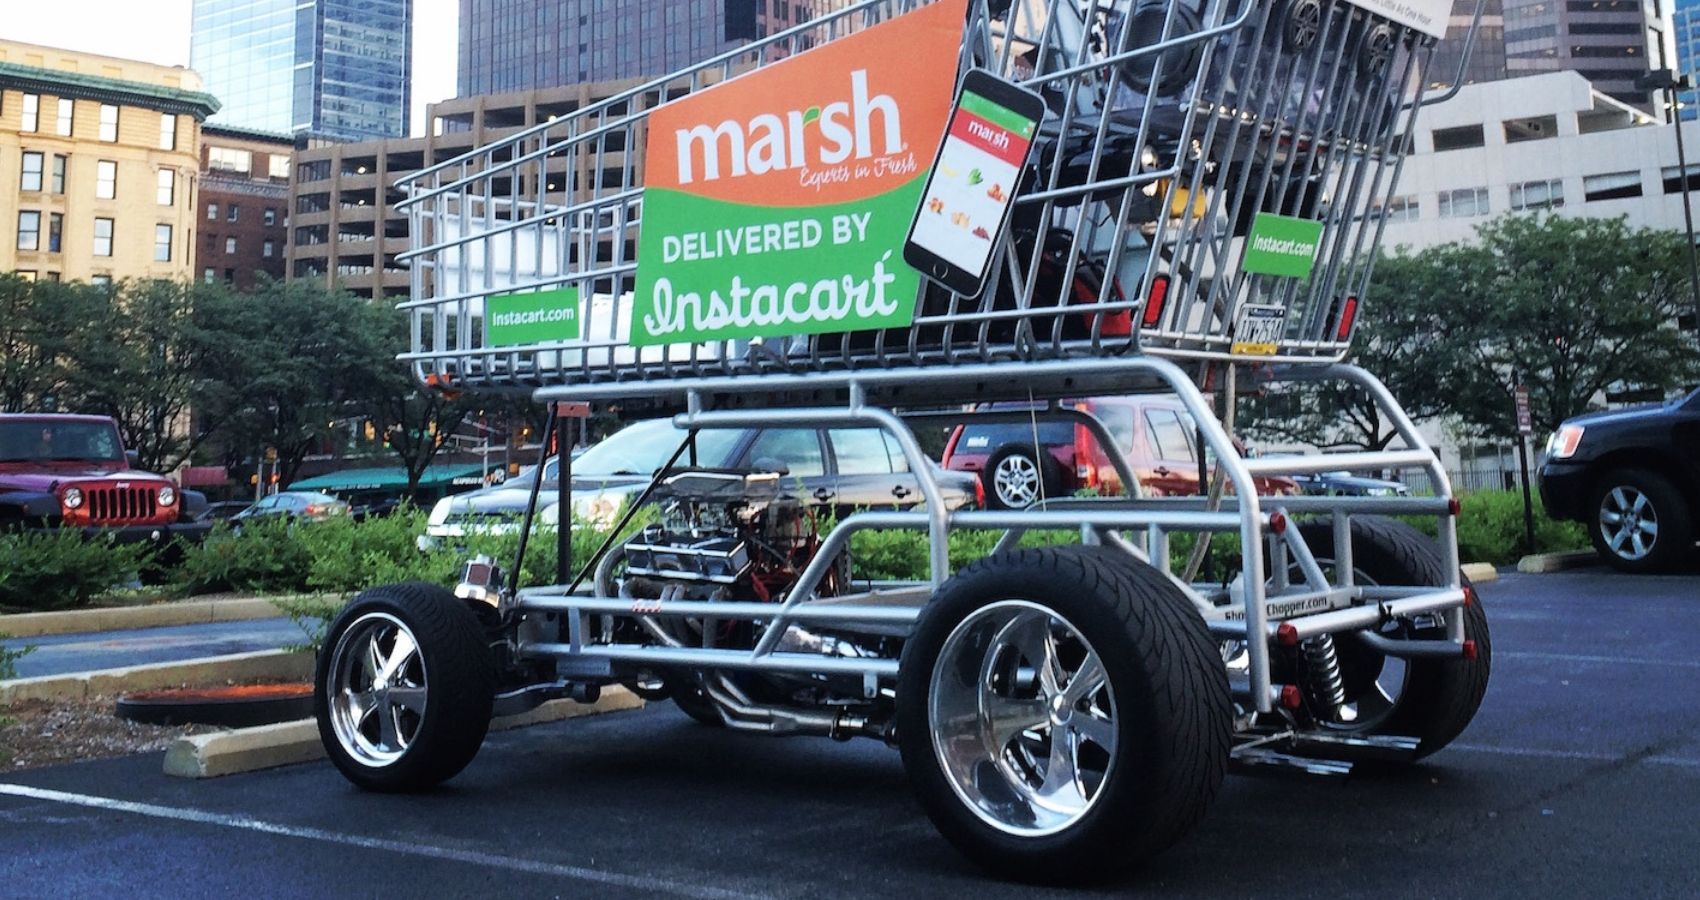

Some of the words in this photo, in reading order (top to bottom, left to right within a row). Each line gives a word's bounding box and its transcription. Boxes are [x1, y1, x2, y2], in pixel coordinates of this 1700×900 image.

[676, 69, 903, 184] marsh
[968, 120, 1009, 149] marsh
[800, 167, 850, 191] Experts
[855, 167, 870, 179] in
[874, 152, 917, 175] Fresh
[663, 218, 823, 264] DELIVERED
[832, 211, 872, 245] BY
[1252, 234, 1314, 256] Instacart.com
[643, 249, 898, 336] Instacart
[492, 307, 575, 327] Instacart.com
[1266, 597, 1327, 617] Chopper.com
